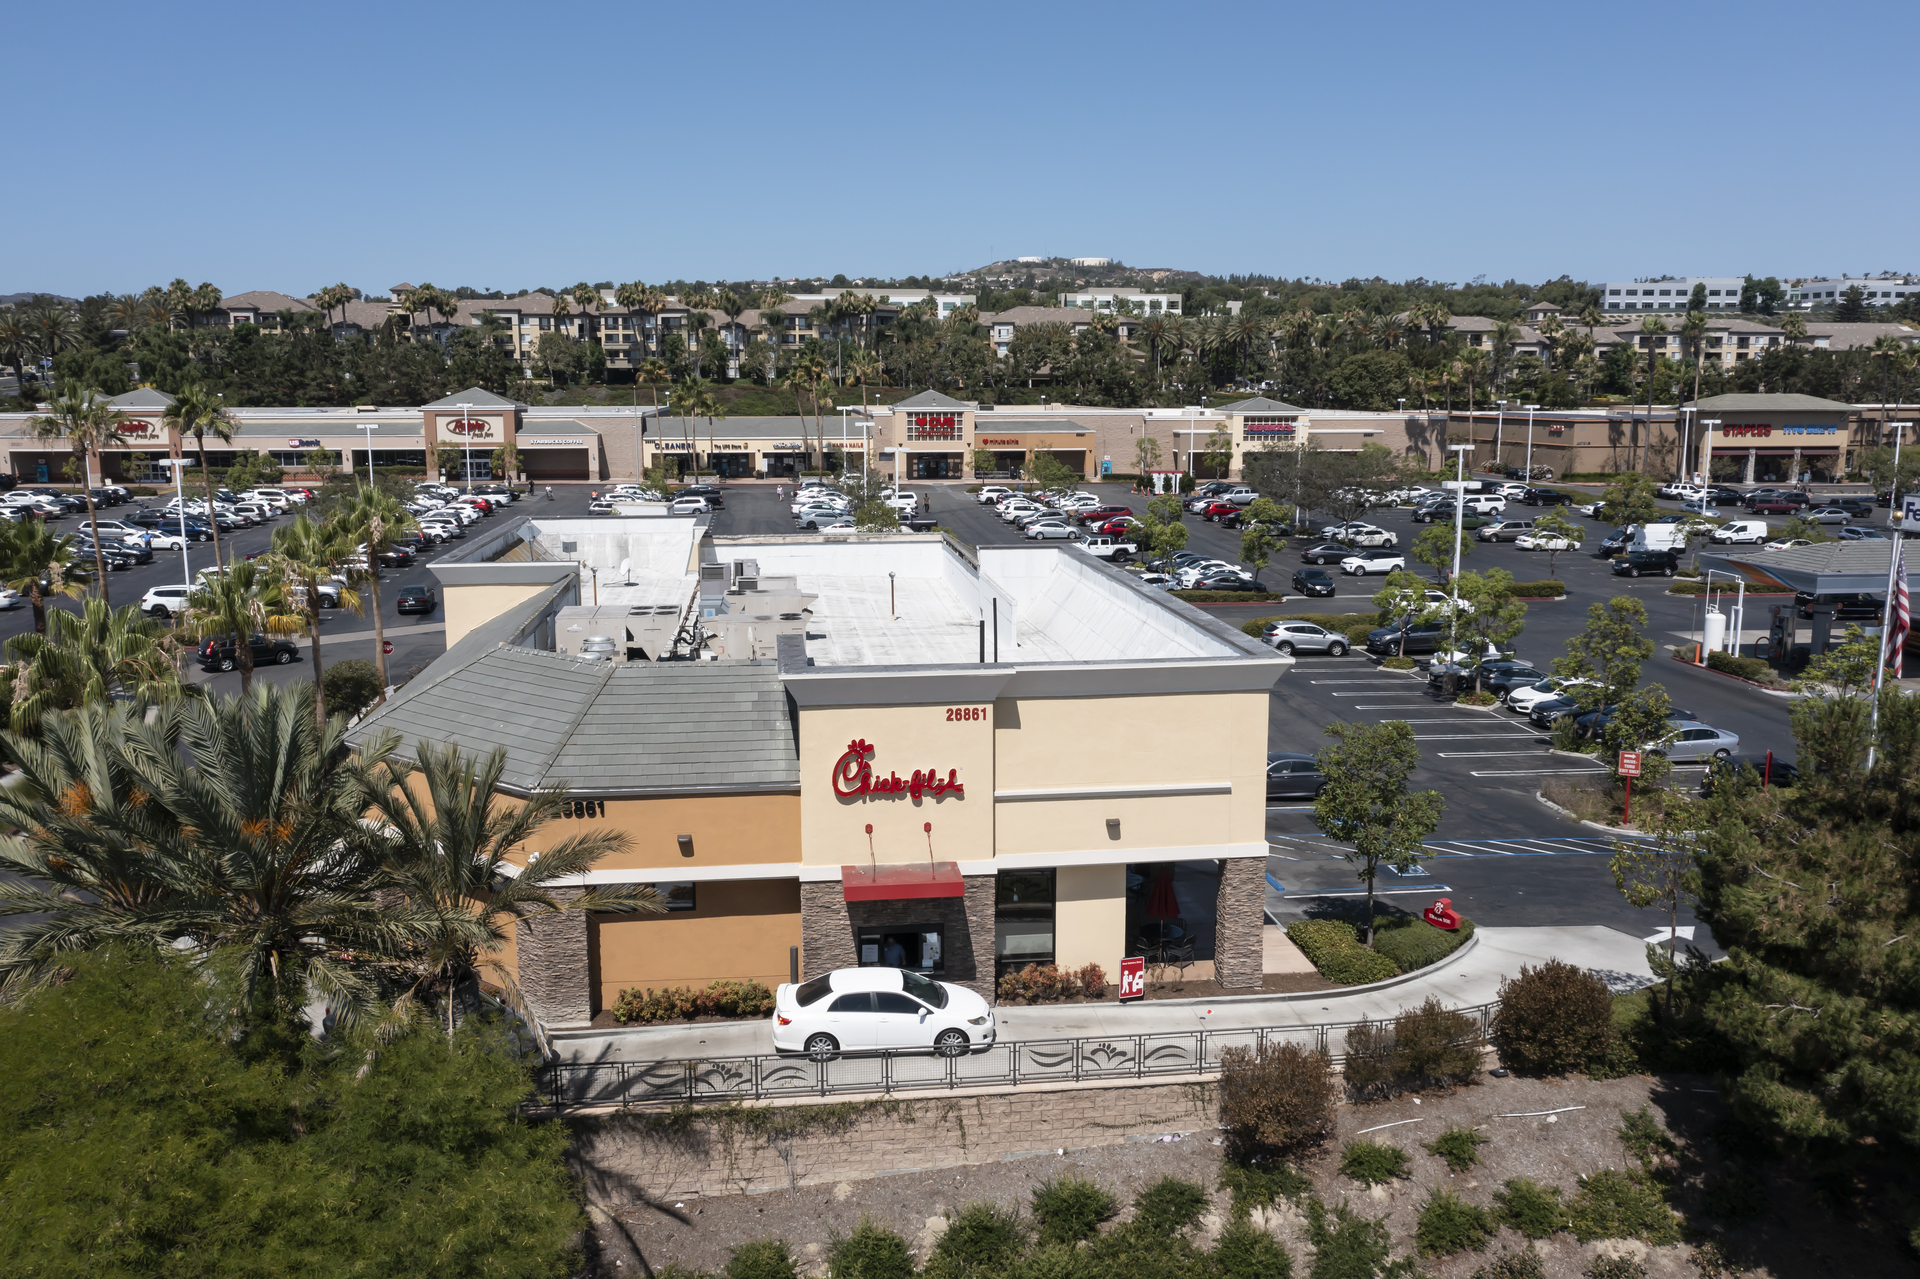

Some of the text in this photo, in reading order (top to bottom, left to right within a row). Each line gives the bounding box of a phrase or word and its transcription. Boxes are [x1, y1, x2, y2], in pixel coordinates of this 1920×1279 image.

[116, 420, 149, 433] Ralphs
[453, 420, 485, 432] Ralphs
[929, 417, 955, 427] CVS
[918, 429, 954, 437] pharmacy
[1723, 424, 1771, 435] STAPLES
[946, 707, 987, 721] 26861
[832, 740, 963, 799] Chick-fil-A
